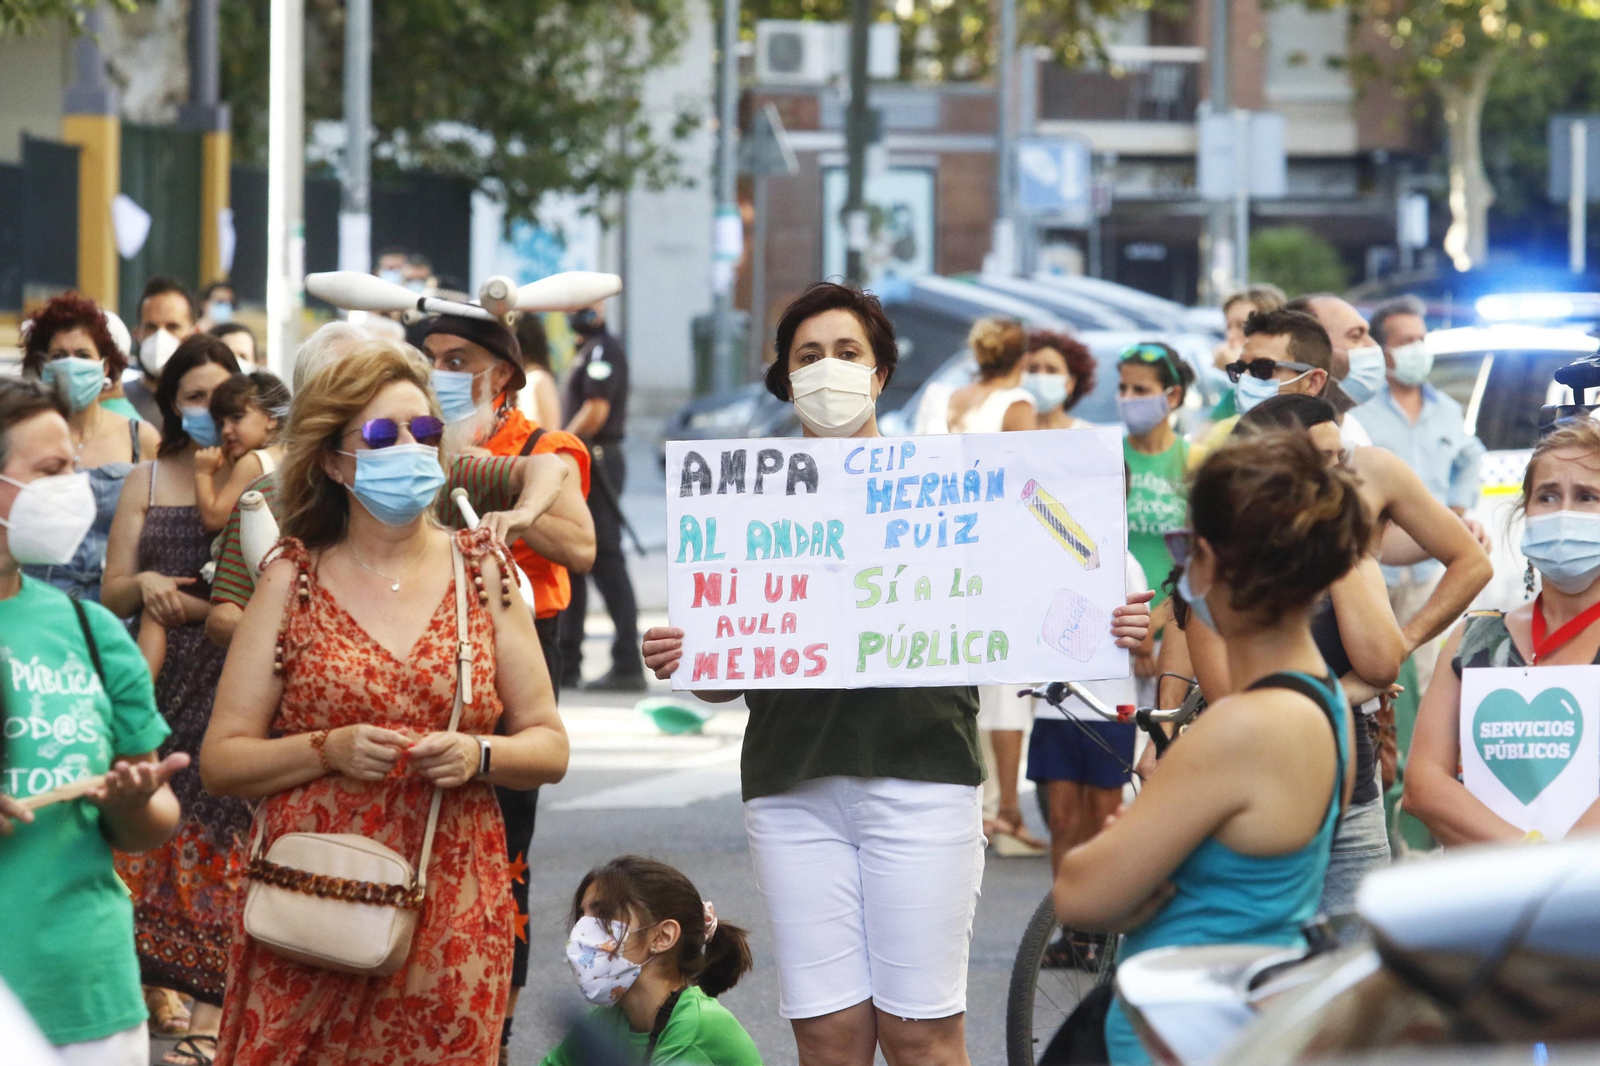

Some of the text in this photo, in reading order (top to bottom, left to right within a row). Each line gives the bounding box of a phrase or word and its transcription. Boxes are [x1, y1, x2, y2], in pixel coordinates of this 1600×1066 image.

[679, 448, 819, 497] AMPA
[844, 441, 916, 475] CEIP
[866, 460, 1005, 515] HERNÁN
[674, 514, 845, 563] AL ANDAR
[764, 574, 809, 603] UN
[914, 575, 932, 601] A
[948, 568, 982, 598] LA
[715, 612, 797, 638] AULA
[8, 655, 104, 695] PÚBLICA
[691, 643, 829, 682] MENOS
[4, 714, 99, 745] OD@S
[1480, 721, 1575, 738] SERVICIOS
[1484, 740, 1570, 760] PÚBLICOS
